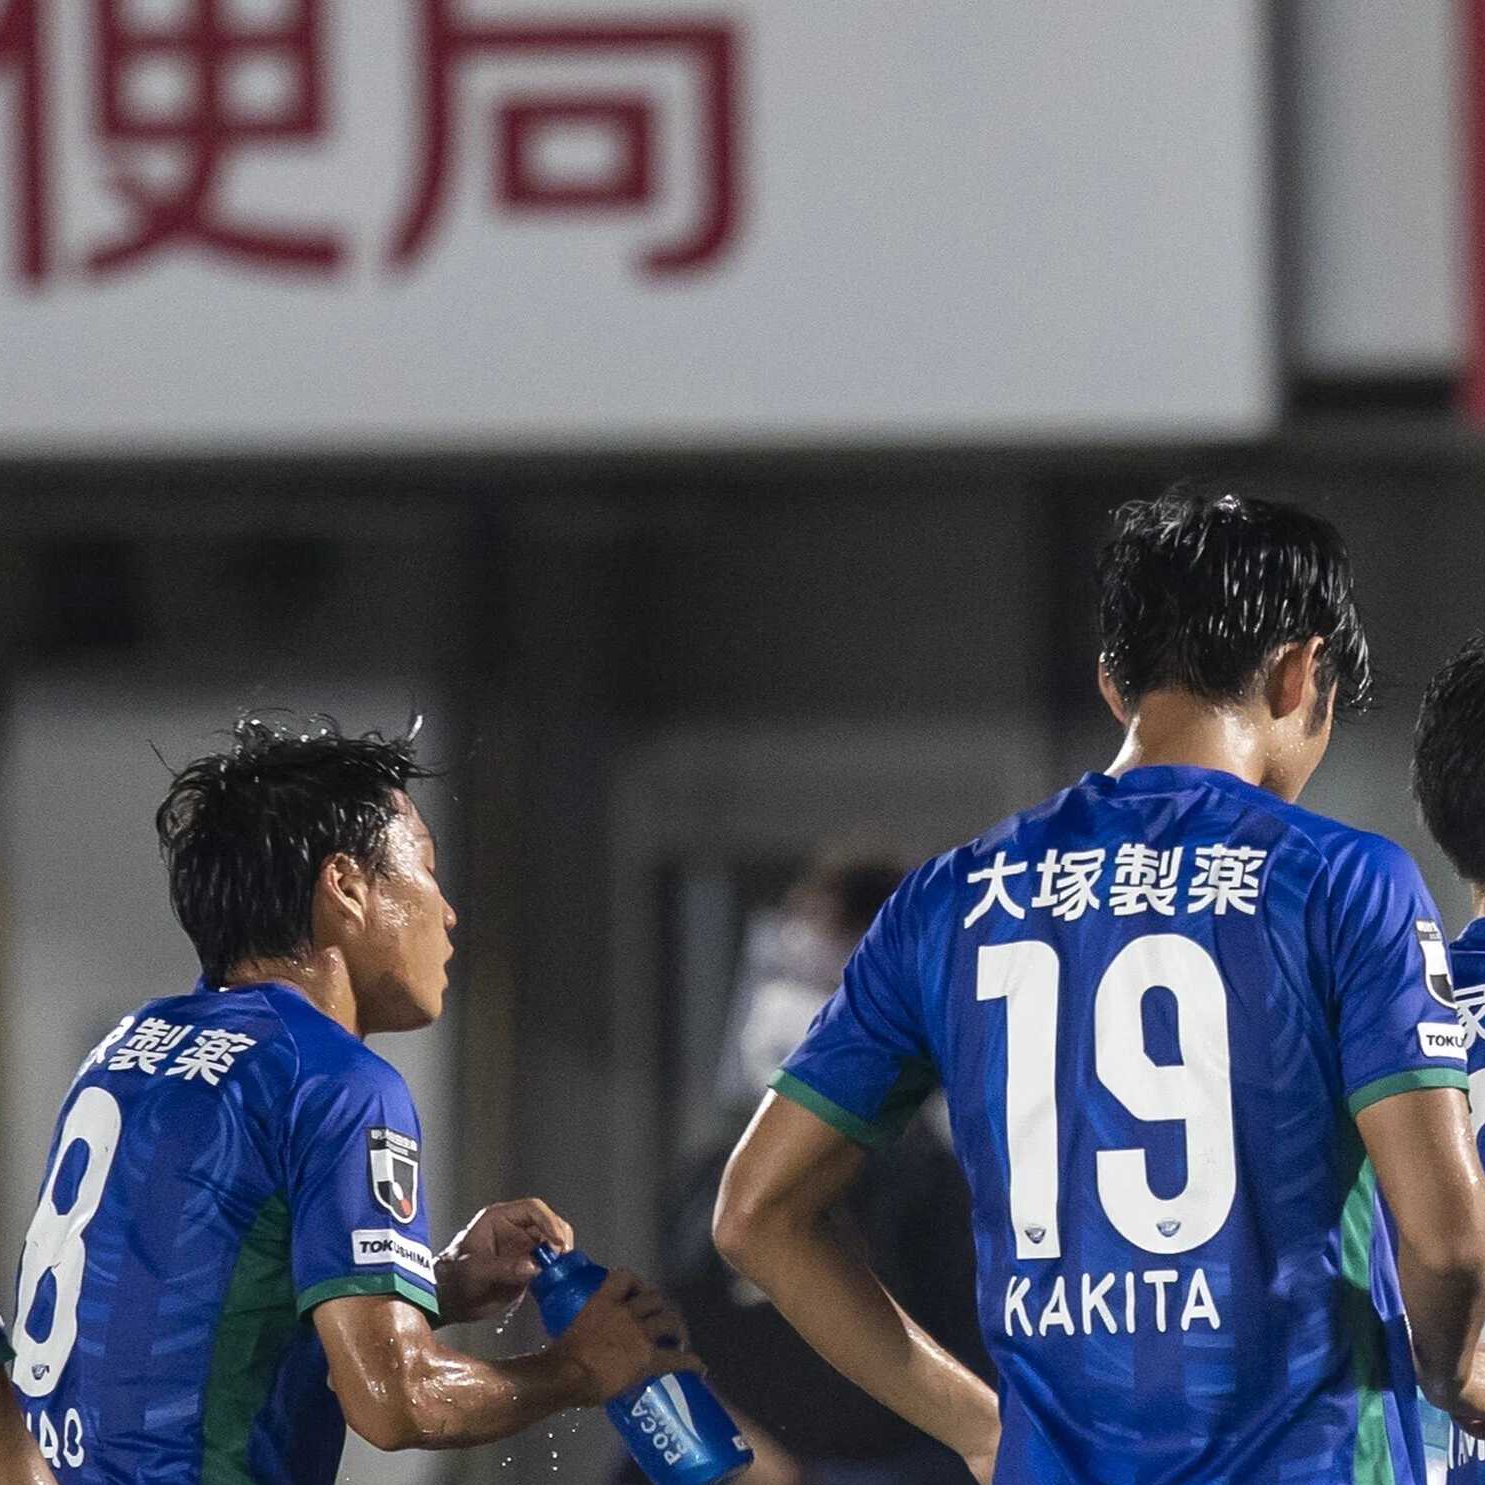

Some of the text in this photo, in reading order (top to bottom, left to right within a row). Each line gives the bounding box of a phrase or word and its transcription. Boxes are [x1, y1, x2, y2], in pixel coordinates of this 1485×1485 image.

[964, 844, 1267, 928] 大塚製薬
[977, 934, 1237, 1258] 19
[12, 1087, 121, 1397] 8
[359, 1239, 431, 1270] TOKUSHIMA
[1004, 1268, 1221, 1337] KAKITA
